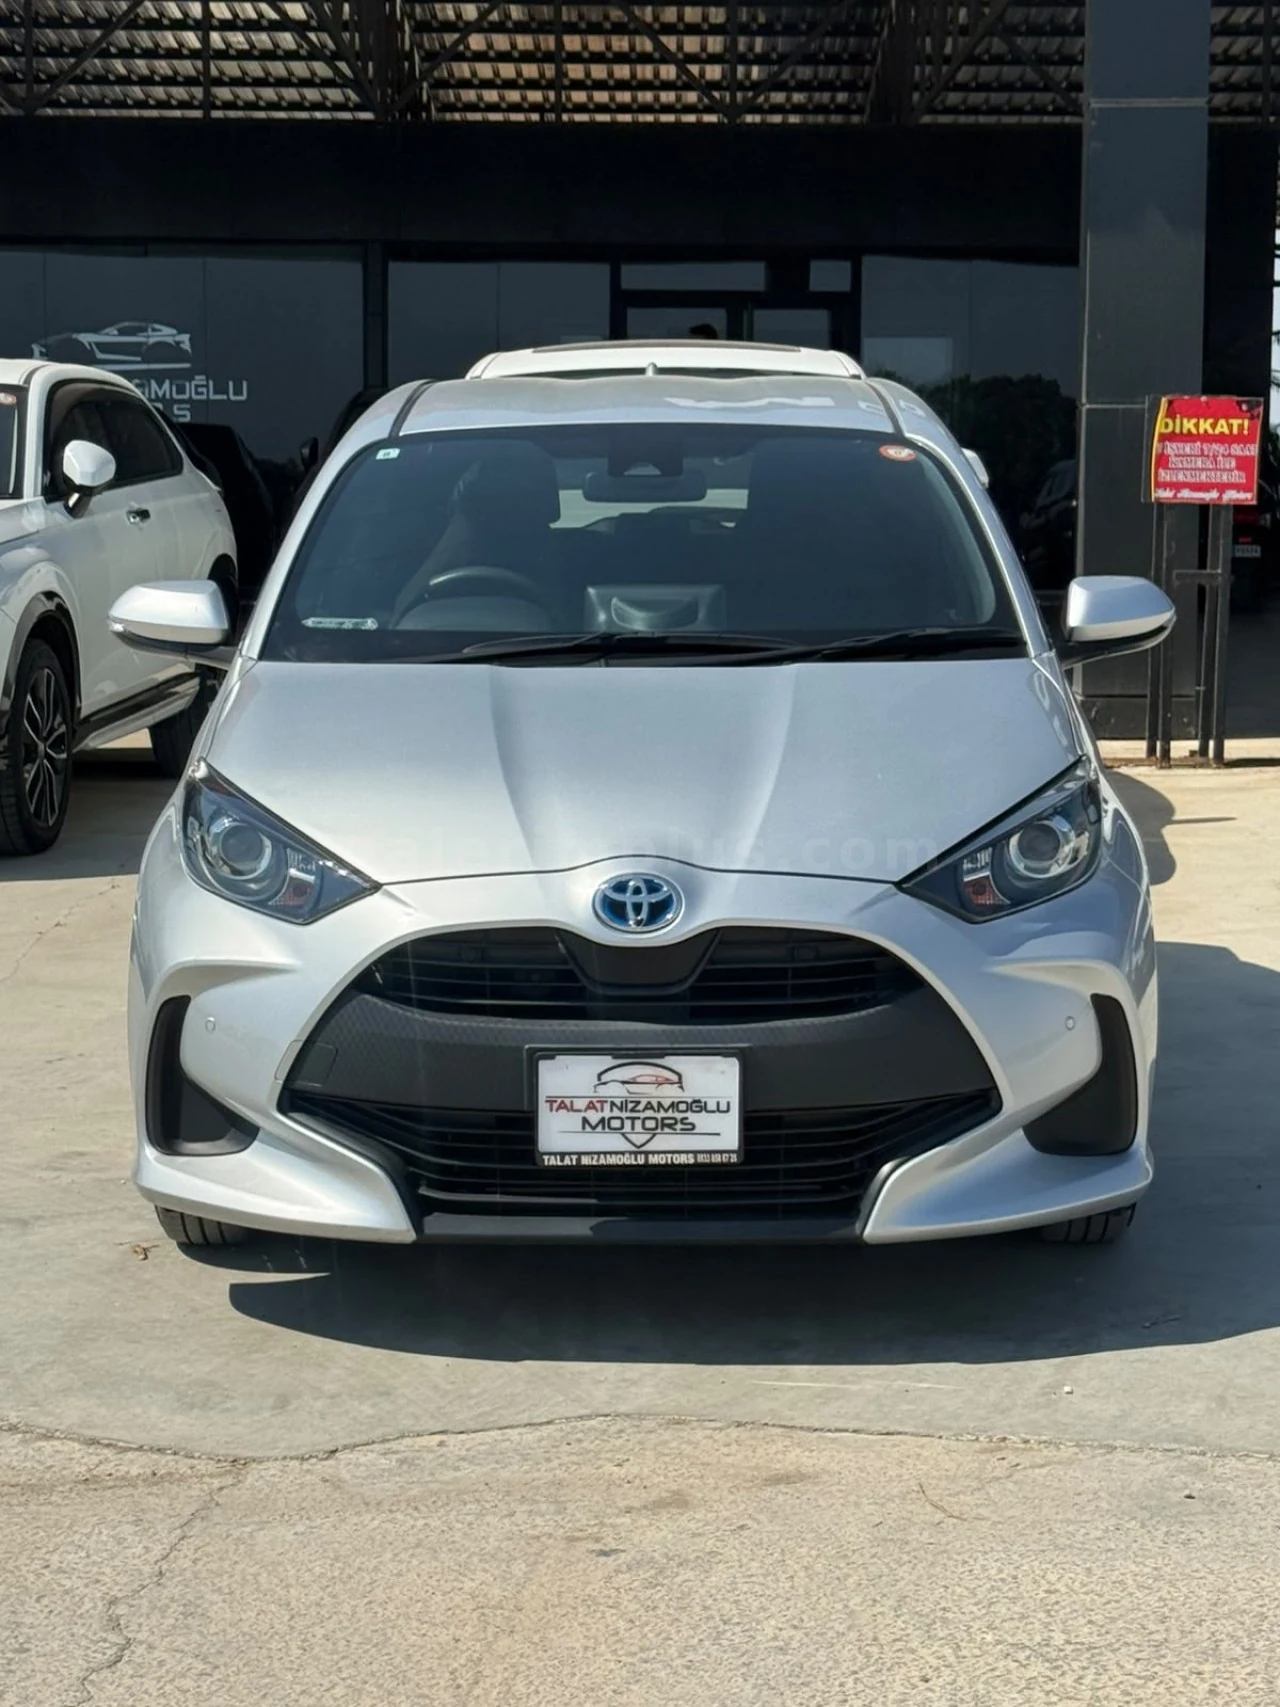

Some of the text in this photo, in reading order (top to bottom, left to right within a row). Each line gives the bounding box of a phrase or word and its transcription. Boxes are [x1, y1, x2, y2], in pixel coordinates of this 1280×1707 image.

[1160, 415, 1248, 434] DİKKAT!
[581, 1116, 696, 1132] MOTORS
[542, 1154, 578, 1166] TALAT
[648, 1152, 695, 1165] MOTORS
